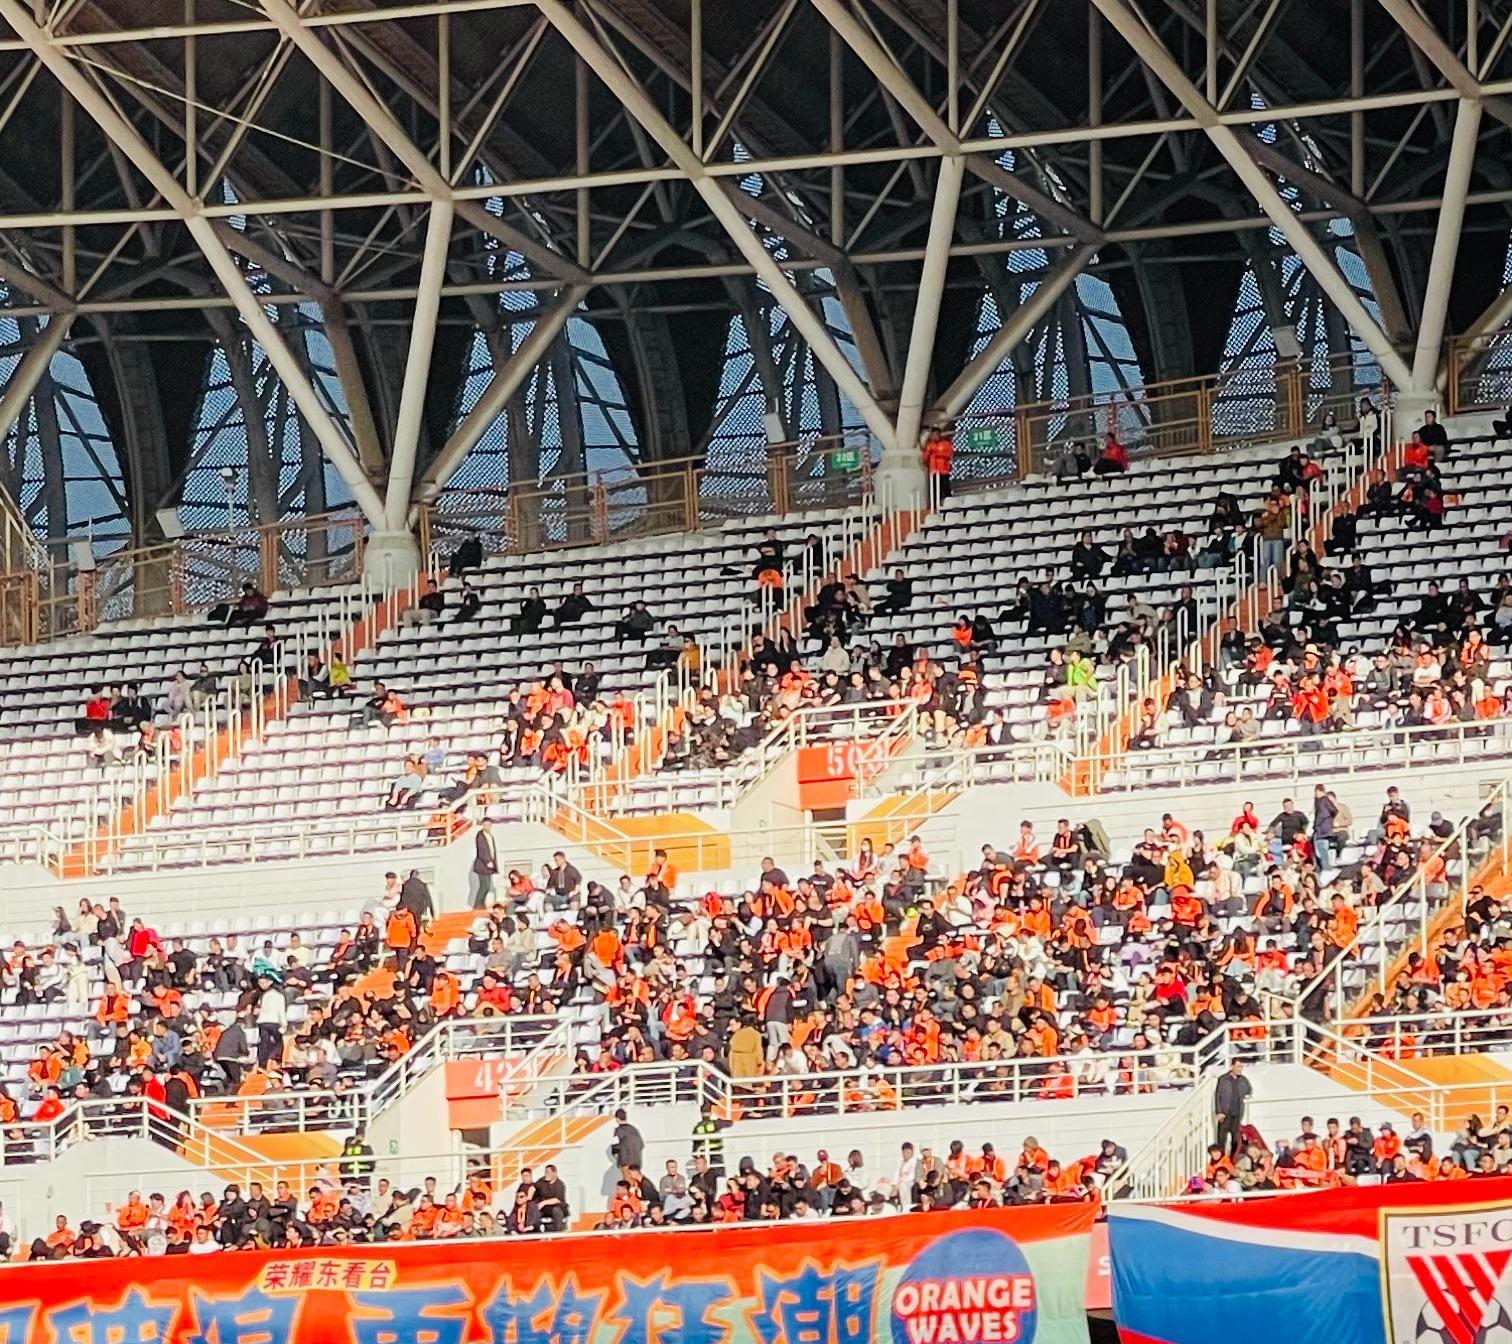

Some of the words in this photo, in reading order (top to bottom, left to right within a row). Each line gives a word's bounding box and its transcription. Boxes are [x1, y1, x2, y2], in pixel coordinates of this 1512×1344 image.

[263, 1260, 392, 1291] 荣耀东看台
[896, 1276, 1033, 1315] ORANGE
